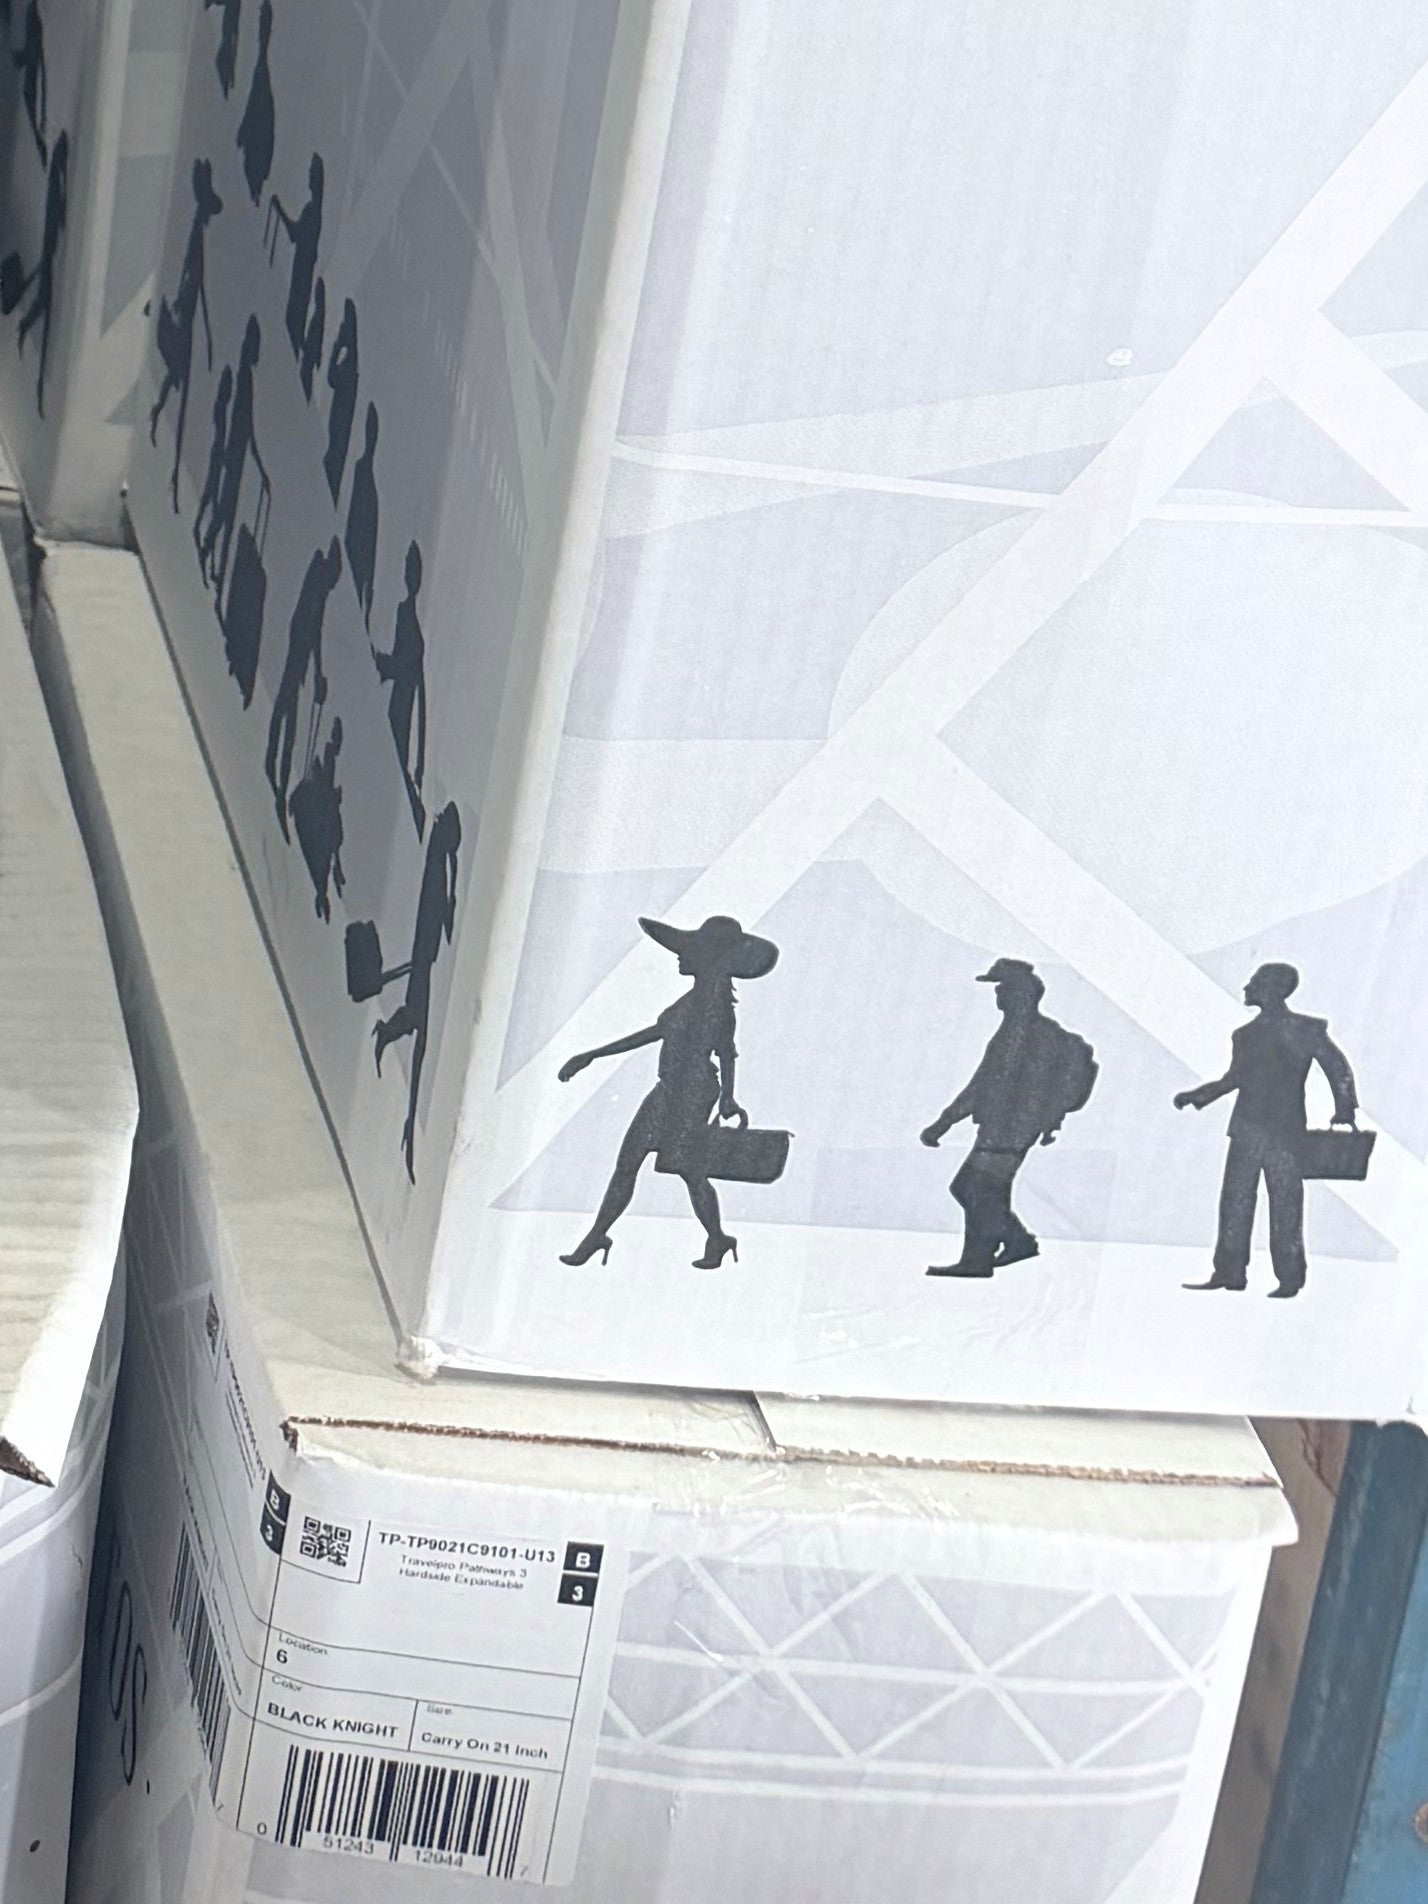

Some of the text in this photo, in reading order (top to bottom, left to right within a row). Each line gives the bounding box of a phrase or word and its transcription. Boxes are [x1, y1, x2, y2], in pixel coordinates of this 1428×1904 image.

[378, 1531, 555, 1563] TP-TP9021C9101-U13
[401, 1554, 456, 1571] Travelpro
[575, 1551, 591, 1568] B
[572, 1585, 584, 1602] 3
[278, 1632, 328, 1657] Location
[276, 1648, 288, 1664] 6
[267, 1702, 399, 1739] BLACK KNIGHT
[422, 1731, 549, 1760] Carry On 21 Inch
[257, 1822, 268, 1836] 0
[323, 1836, 375, 1856] 51243
